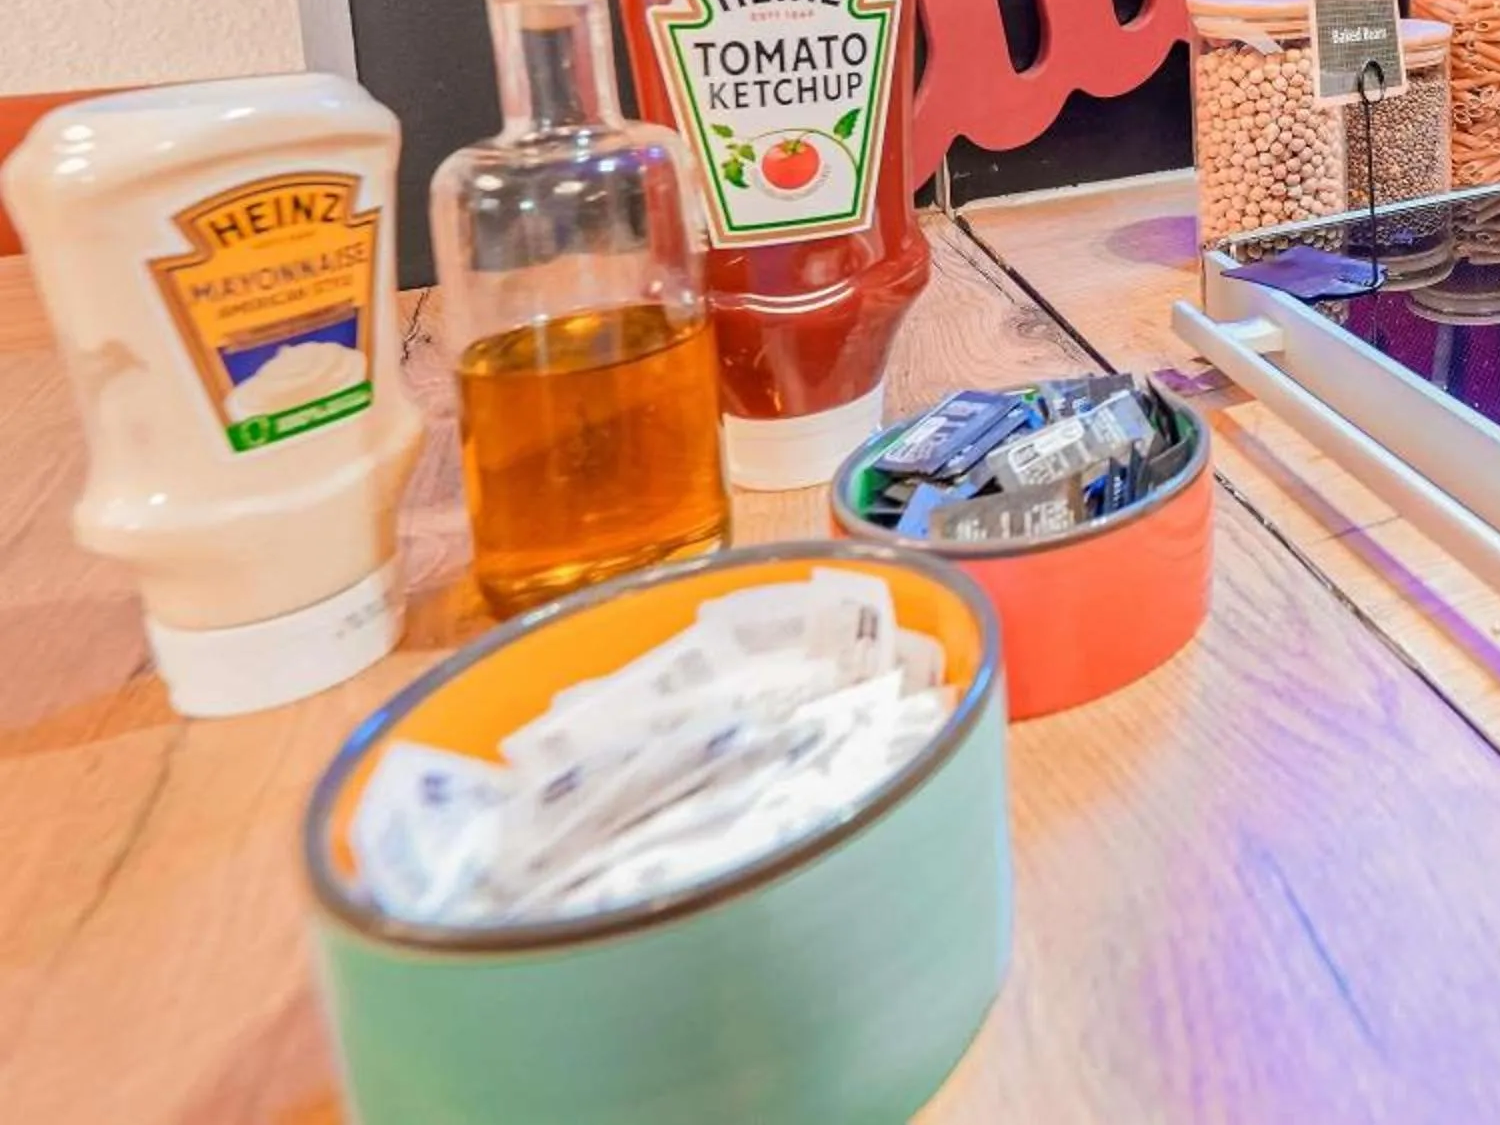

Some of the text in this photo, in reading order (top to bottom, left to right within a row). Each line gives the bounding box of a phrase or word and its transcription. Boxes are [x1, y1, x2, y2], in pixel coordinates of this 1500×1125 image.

[693, 32, 867, 77] TOMATO
[709, 72, 864, 110] KETCHUP
[208, 192, 341, 249] HEINZ
